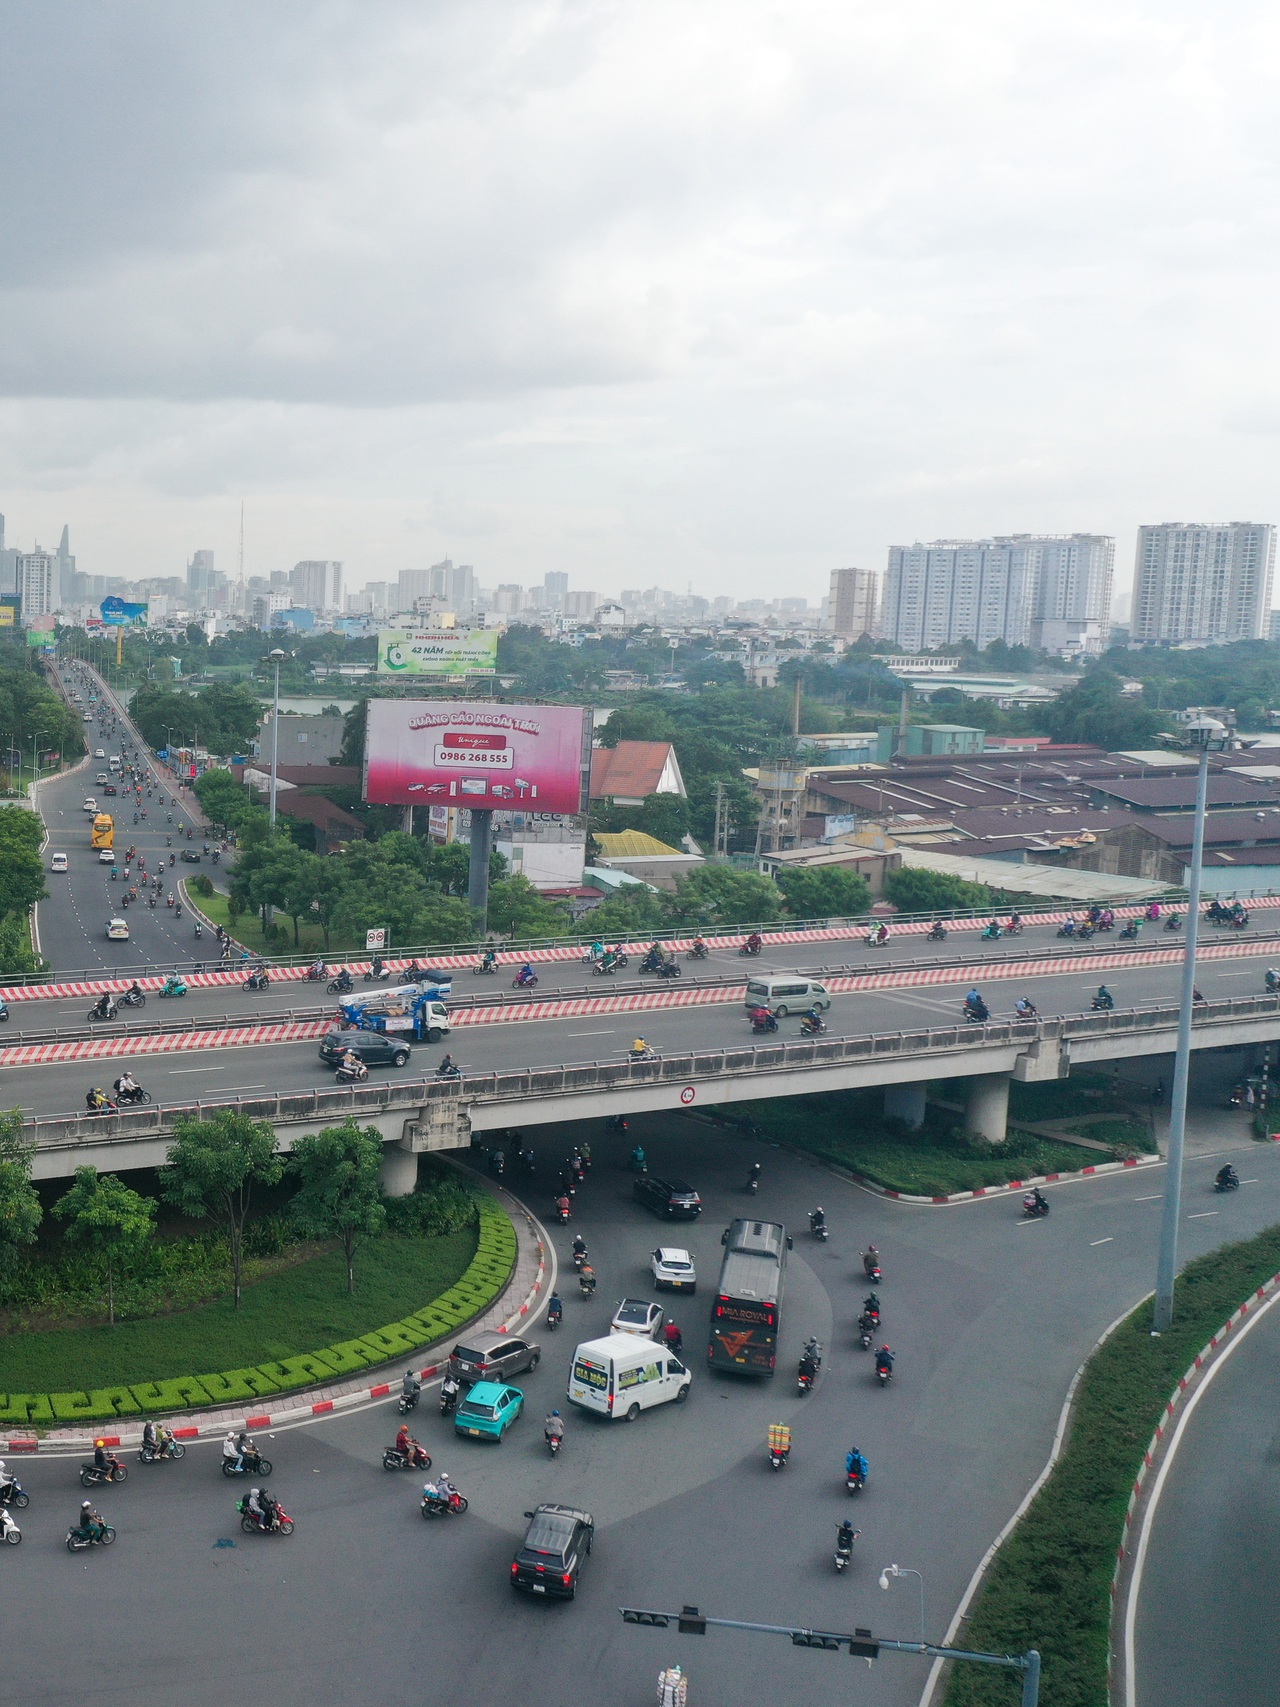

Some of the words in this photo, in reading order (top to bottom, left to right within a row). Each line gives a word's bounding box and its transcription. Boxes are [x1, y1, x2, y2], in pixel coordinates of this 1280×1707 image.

[424, 645, 444, 654] NĂM
[408, 713, 449, 729] QUẢNG
[450, 711, 474, 725] CÁO
[476, 714, 512, 729] NGOÀI
[513, 719, 540, 735] TRỜI
[458, 736, 489, 747] Unique
[440, 752, 466, 761] 0986
[468, 753, 487, 762] 268
[490, 754, 508, 763] 555
[740, 1309, 768, 1322] ROYAL
